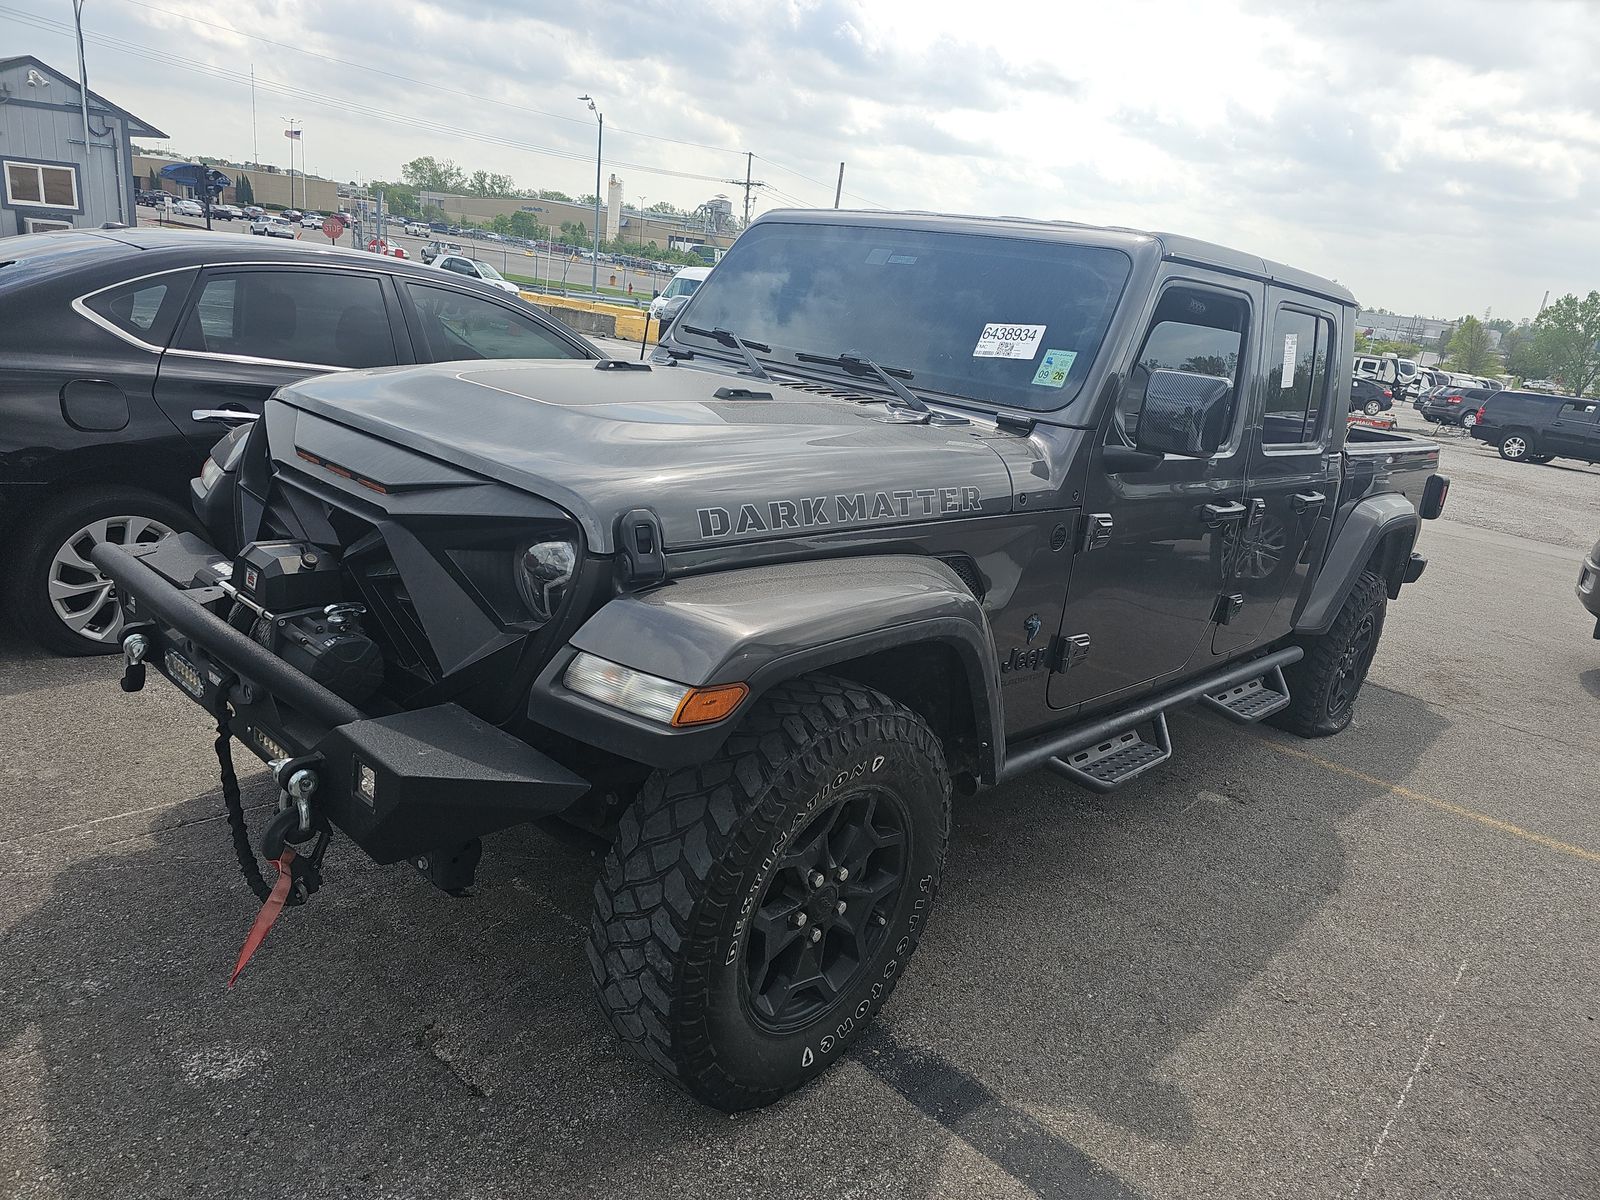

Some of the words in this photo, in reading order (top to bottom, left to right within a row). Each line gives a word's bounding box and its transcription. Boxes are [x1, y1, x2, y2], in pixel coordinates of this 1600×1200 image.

[324, 225, 341, 233] STOP
[982, 327, 1038, 342] 6438934
[1038, 370, 1050, 380] 09
[1053, 371, 1065, 381] 26
[696, 496, 831, 539] DARK
[836, 485, 983, 524] MATTER
[1001, 647, 1048, 673] Jeep
[725, 760, 868, 966] DESTINATION
